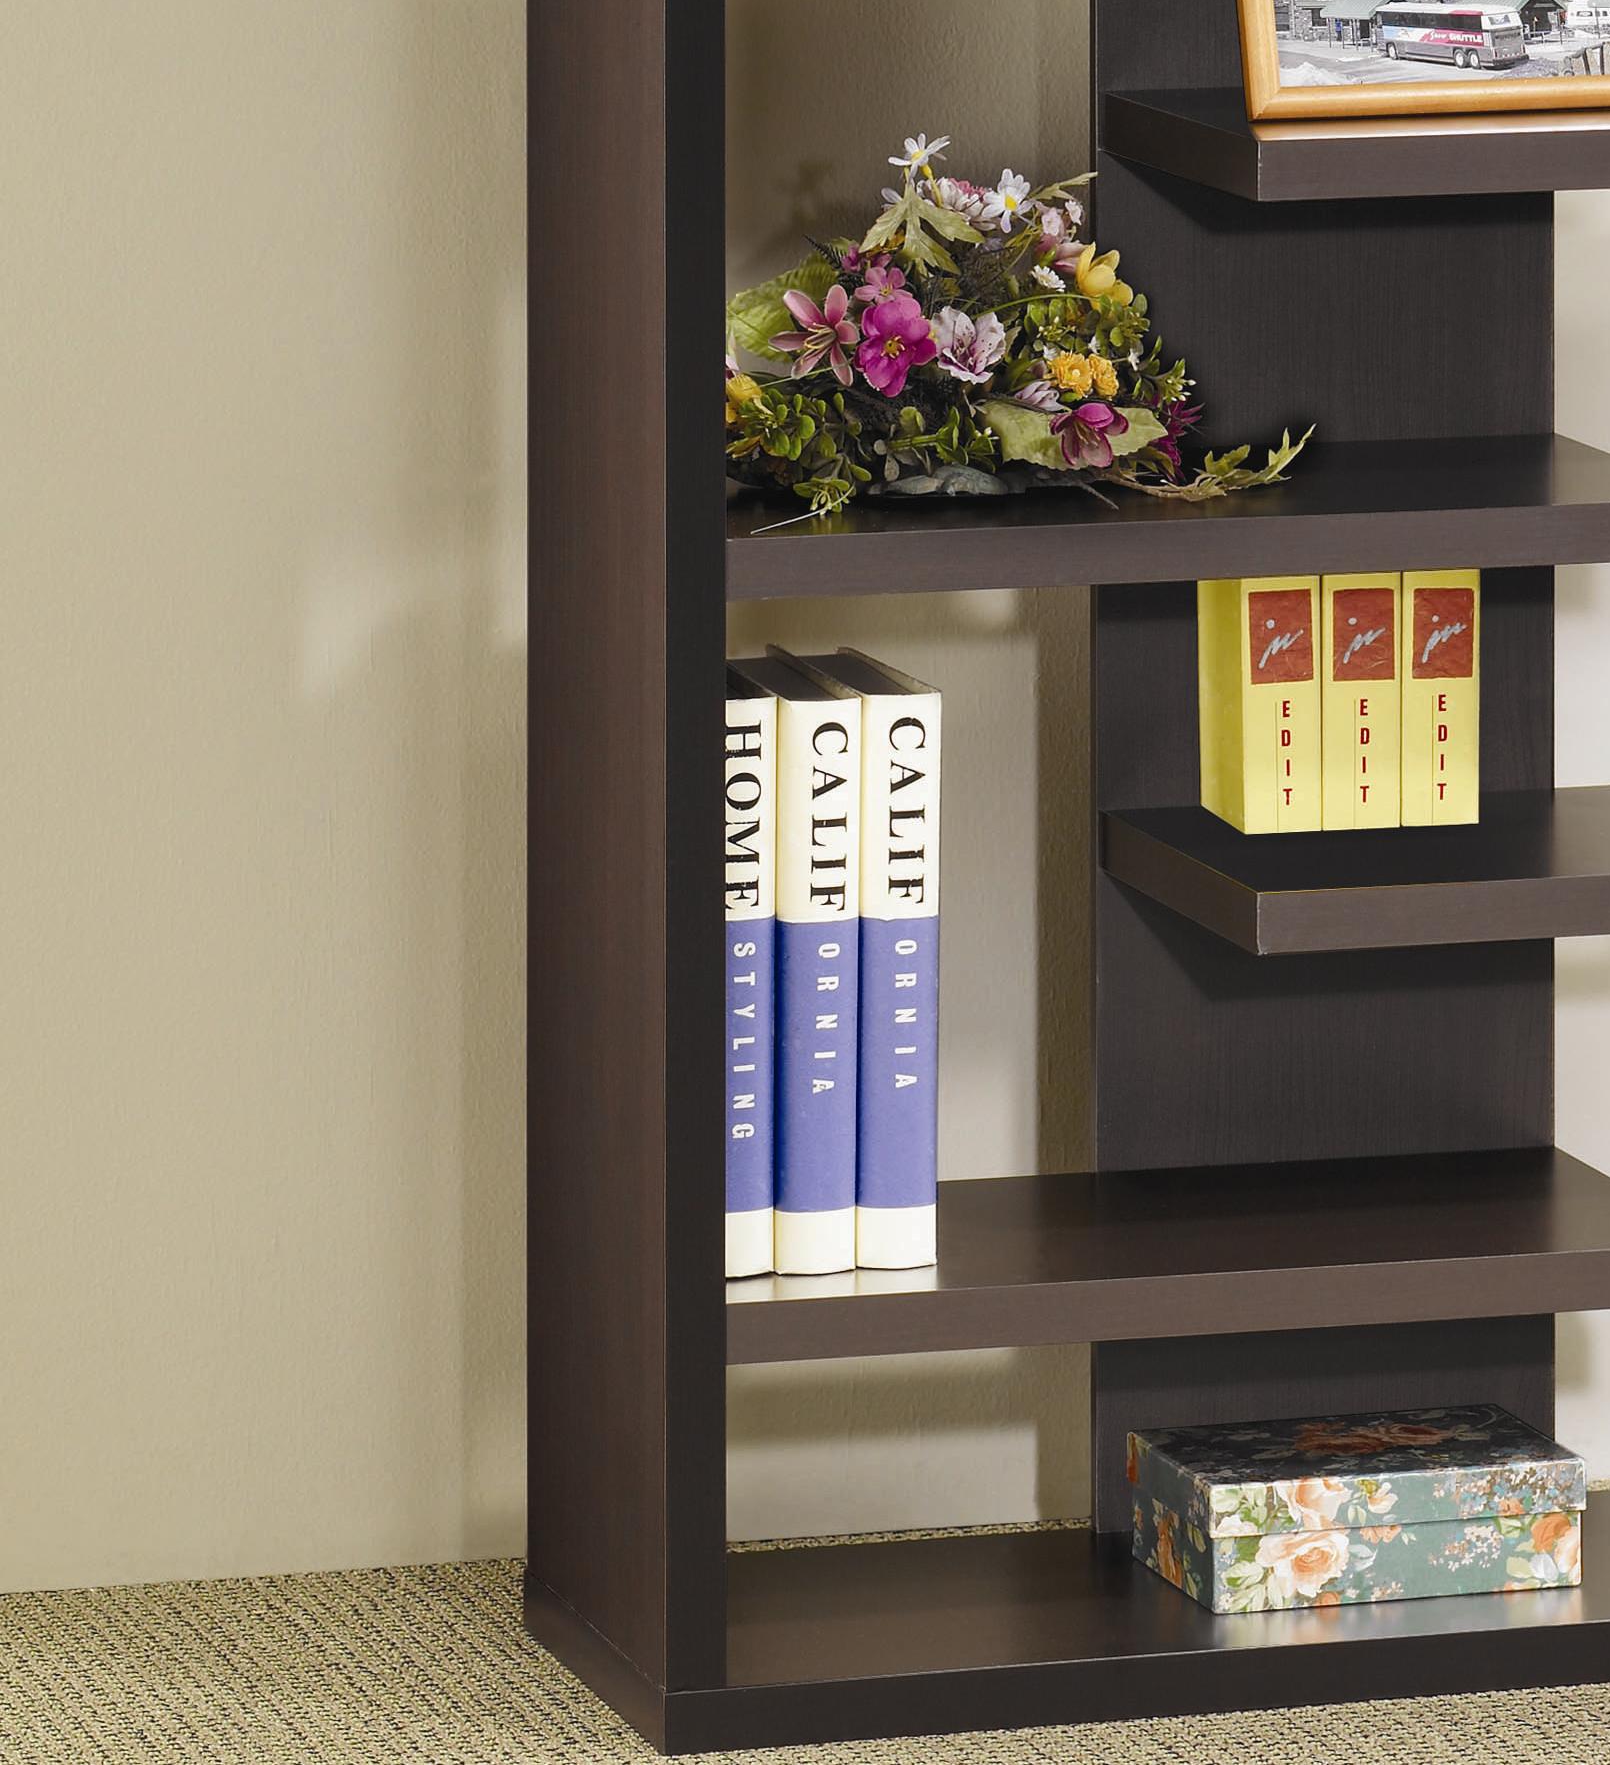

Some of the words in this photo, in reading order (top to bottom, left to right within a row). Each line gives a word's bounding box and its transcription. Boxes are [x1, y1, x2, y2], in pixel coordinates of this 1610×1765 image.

[725, 719, 762, 911] HOME
[810, 720, 849, 912] CALIF
[887, 715, 927, 905] CALIF
[1280, 699, 1293, 806] EDIT
[1358, 698, 1371, 804] EDIT
[1436, 693, 1449, 801] EDIT
[731, 941, 757, 1140] STYLING
[812, 942, 841, 1095] ORNIA
[894, 938, 918, 1089] ORNIA
